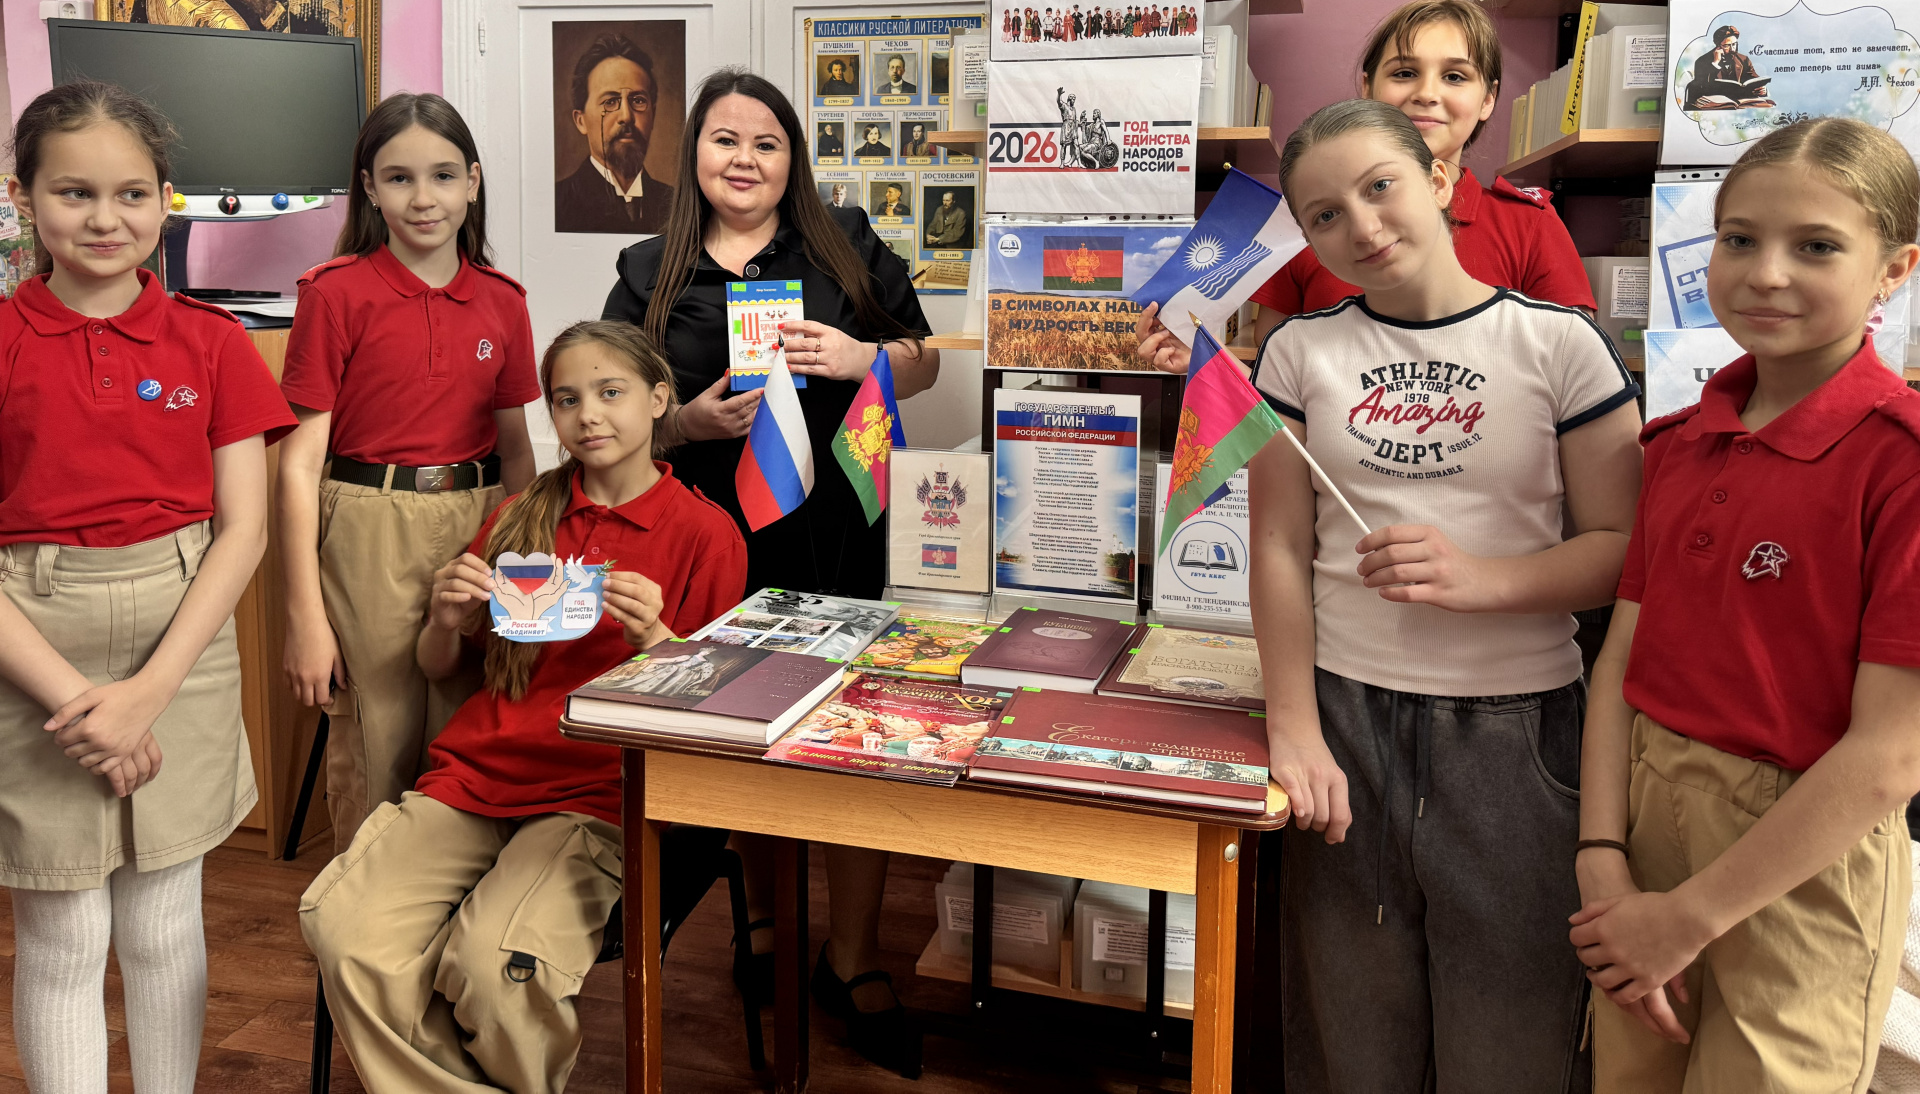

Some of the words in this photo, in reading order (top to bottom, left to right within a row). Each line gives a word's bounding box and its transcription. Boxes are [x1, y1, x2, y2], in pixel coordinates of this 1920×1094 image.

[818, 23, 866, 36] КЛАССИКИ
[869, 20, 910, 35] РУССКОЙ
[914, 19, 977, 34] ЛИТЕРАТУРЫ
[1749, 44, 1799, 56] «Счастлив
[1800, 66, 1832, 74] теперь
[1854, 76, 1882, 91] А.П.
[1886, 74, 1915, 87] Чехов
[1124, 121, 1149, 134] ГОД
[989, 131, 1058, 163] 2026
[1124, 134, 1190, 147] ЕДИНСТВА
[1123, 148, 1184, 160] НАРОДОВ
[1122, 162, 1175, 172] РОССИИ
[1676, 266, 1708, 287] ОТ
[1682, 288, 1706, 304] В
[992, 299, 1001, 311] В
[1006, 299, 1100, 313] СИМВОЛАХ
[1106, 301, 1144, 314] НАШ
[1008, 318, 1099, 332] МУДРОСТЬ
[1104, 321, 1136, 333] ВЕК
[1360, 361, 1486, 391] ATHLETIC
[1385, 381, 1415, 393] NEW
[1420, 381, 1453, 394] YORK
[1404, 393, 1430, 403] 1978
[1015, 402, 1116, 416] ГОСУДАРСТВЕННЫЙ
[1348, 386, 1485, 434] Amazing
[1044, 415, 1085, 428] ГИМН
[1015, 428, 1067, 438] РОССИЙСКОЙ
[1068, 432, 1116, 441] ФЕДЕРАЦИИ
[1345, 424, 1377, 447] TRAINING
[1374, 438, 1444, 464] DEPT
[1447, 432, 1482, 454] ISSUE.12
[1359, 458, 1404, 478] AUTHENTIC
[1426, 464, 1464, 479] DURABLE
[1043, 621, 1098, 632] КУБАНСКИЙ
[1153, 656, 1259, 674] БОГАТСТВА
[951, 692, 1002, 711] ХОР
[1048, 722, 1246, 757] Екатеринодарские
[1150, 748, 1246, 762] страницы
